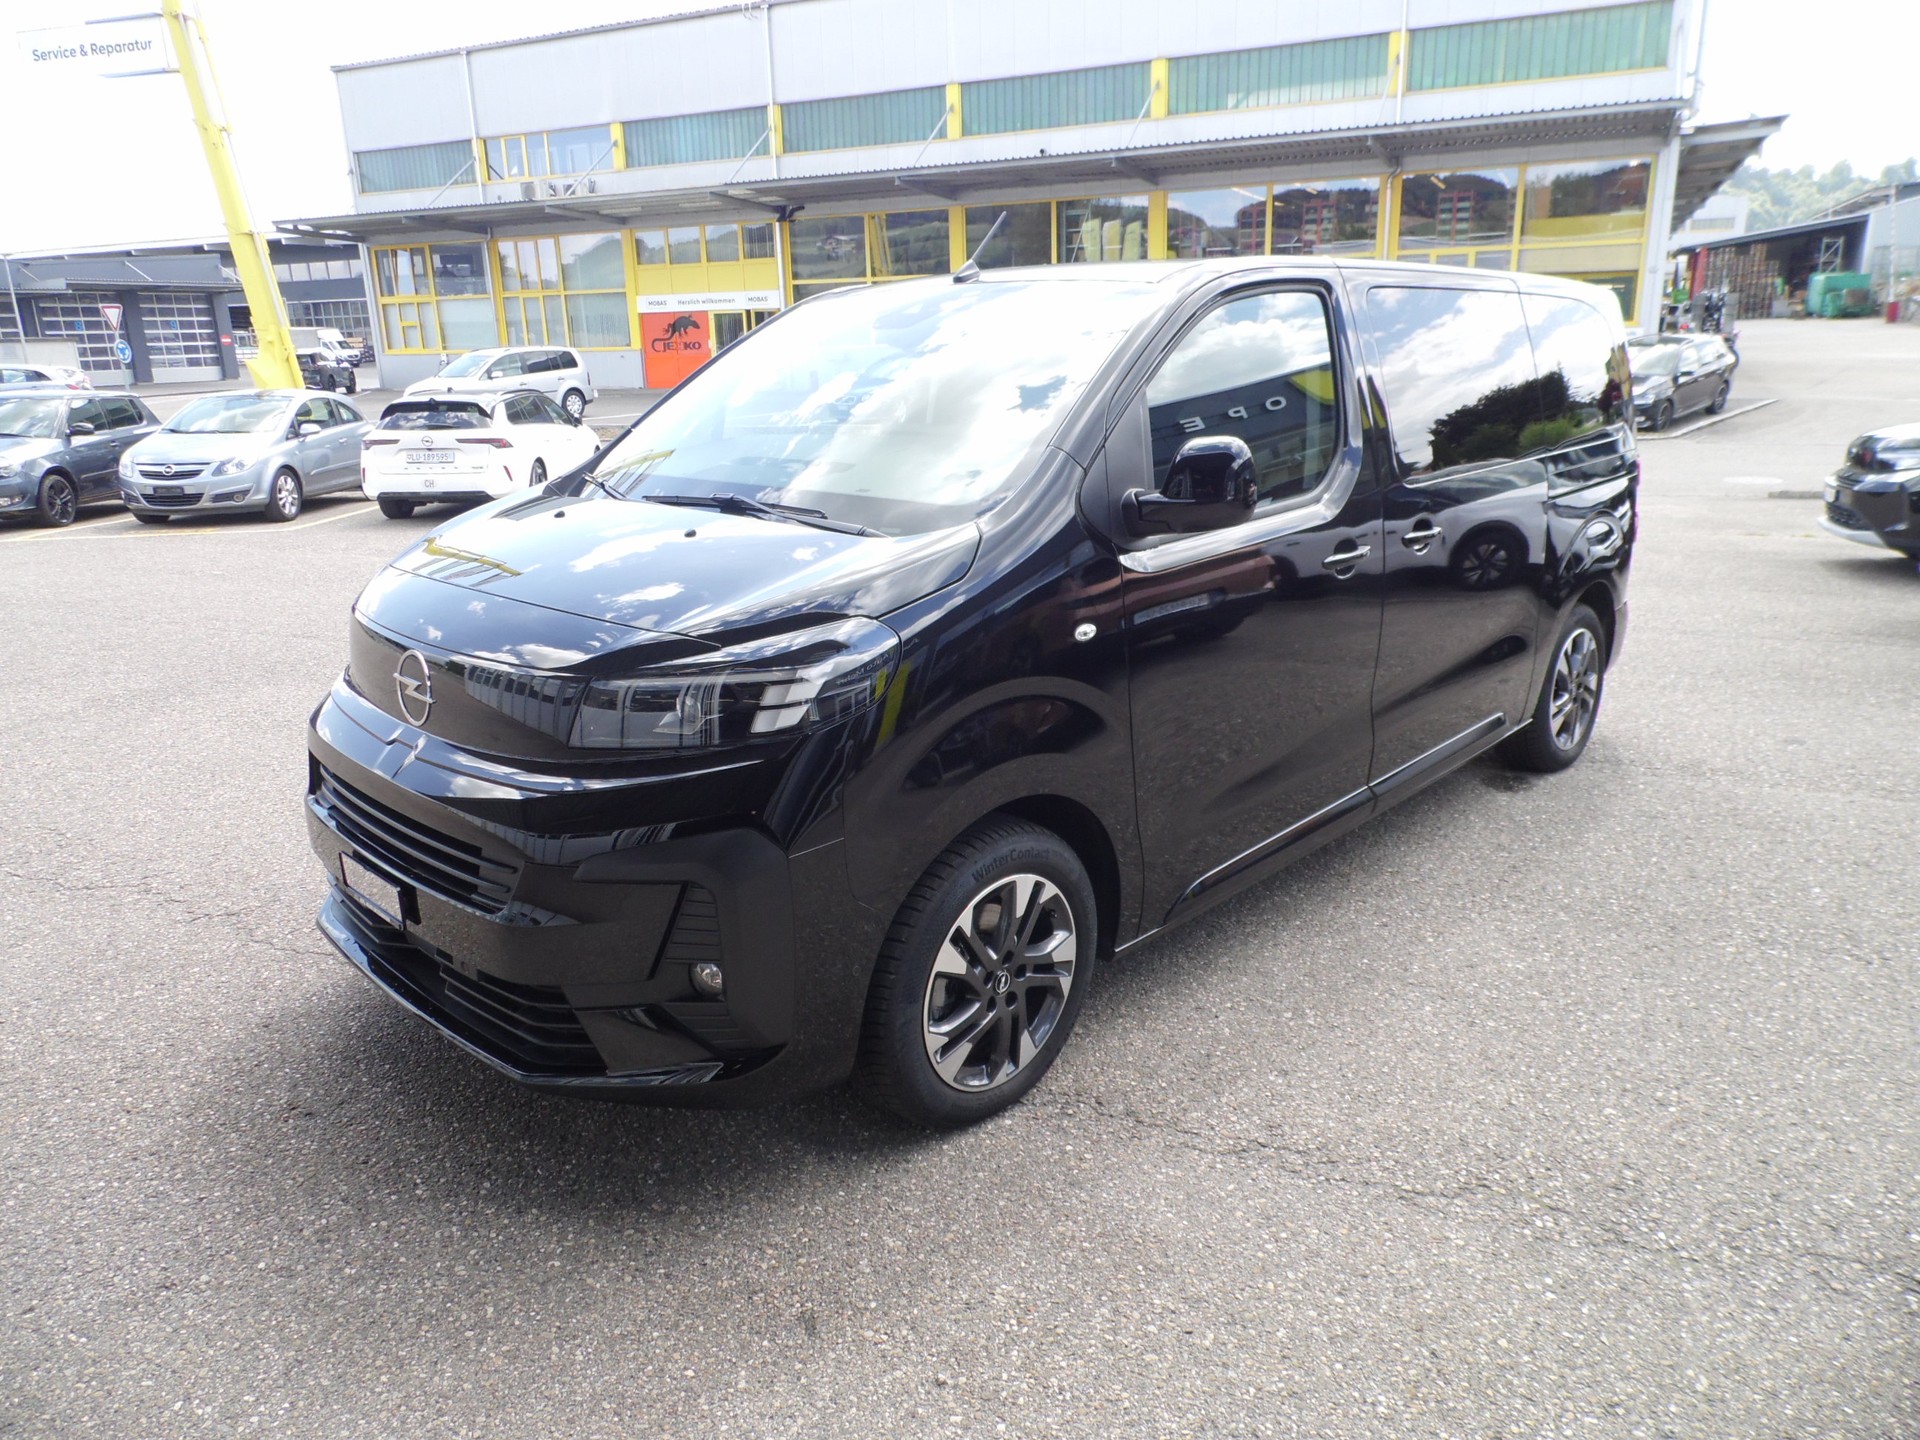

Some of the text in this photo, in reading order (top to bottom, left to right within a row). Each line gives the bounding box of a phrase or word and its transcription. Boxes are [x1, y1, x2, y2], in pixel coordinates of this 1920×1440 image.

[32, 39, 152, 62] Service & Reparatur
[75, 321, 83, 331] 8
[170, 320, 178, 330] 9
[424, 480, 435, 488] CH
[971, 846, 1050, 882] WinterContact
